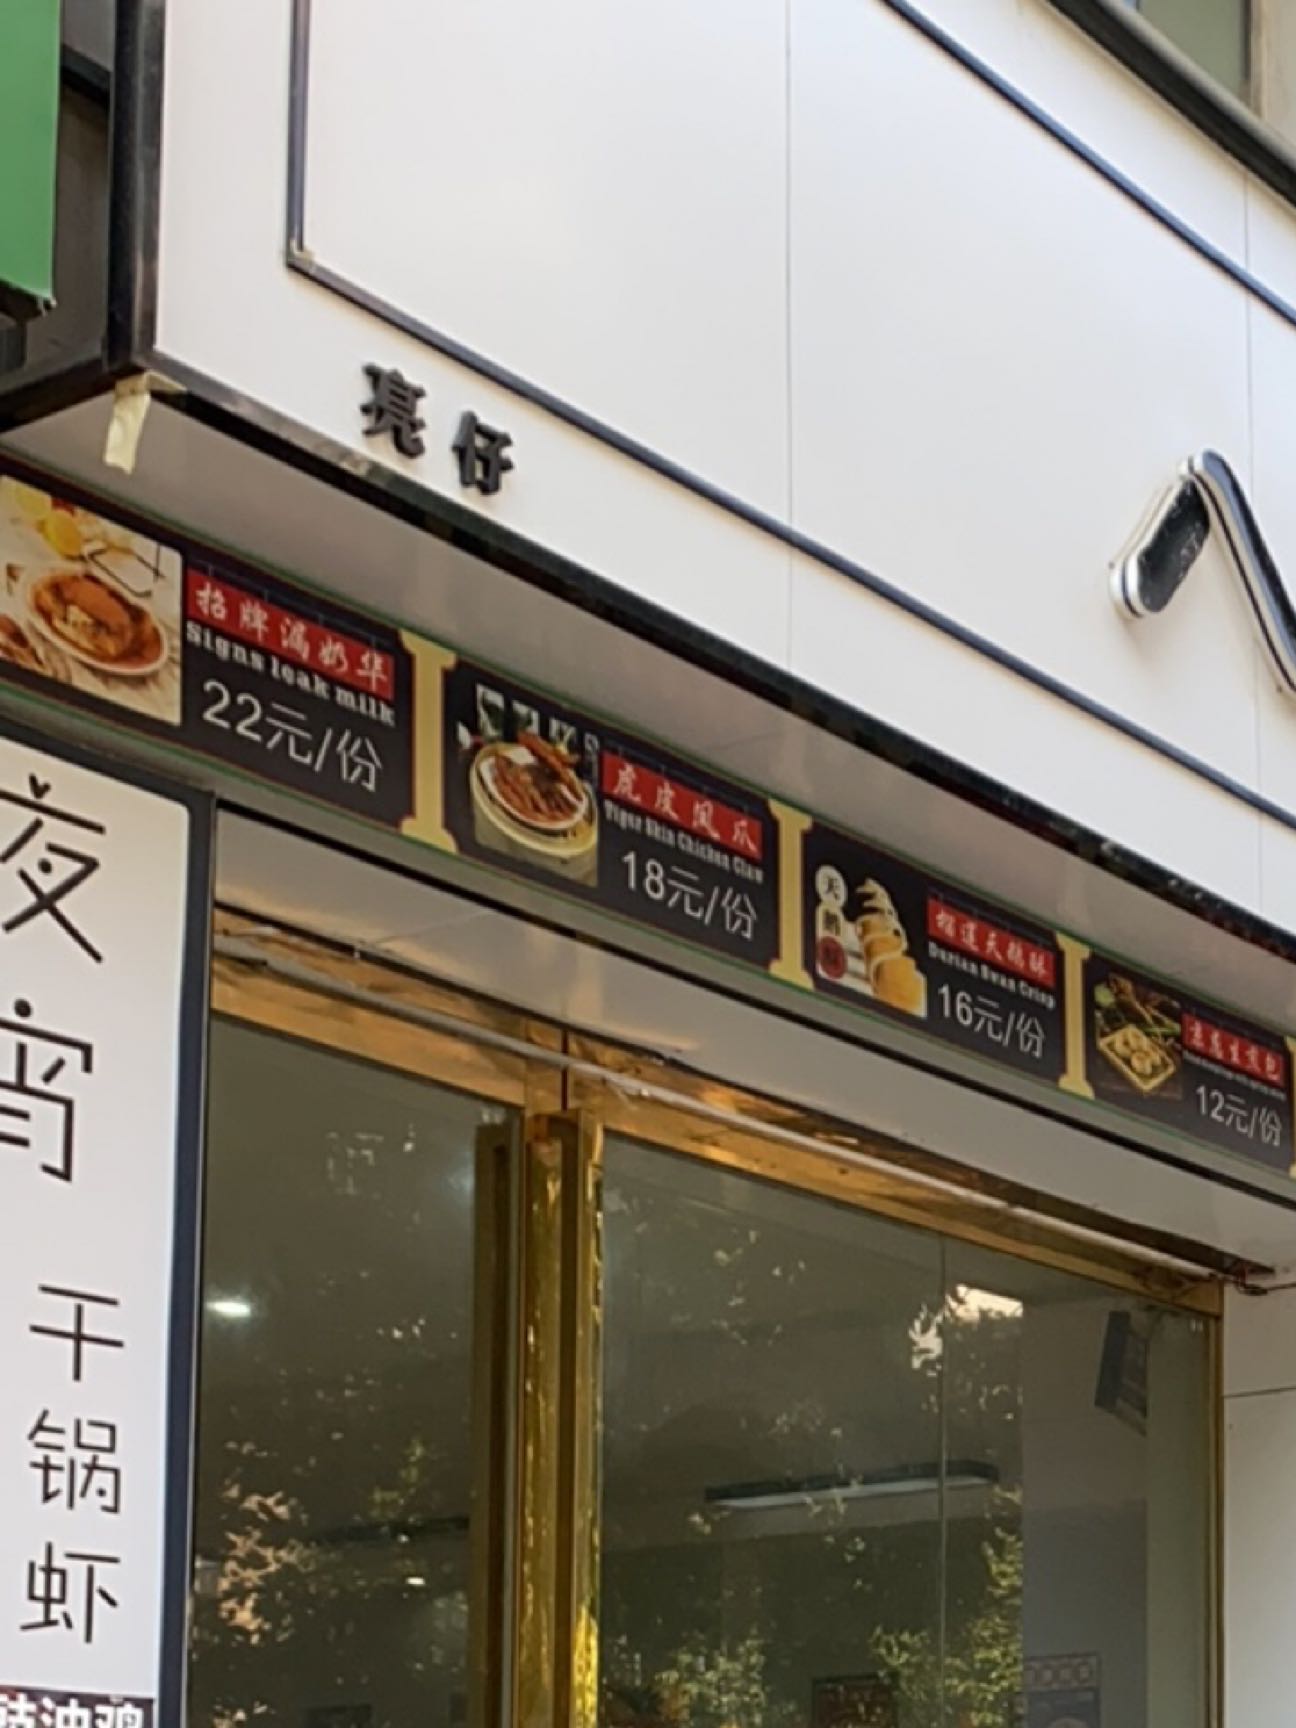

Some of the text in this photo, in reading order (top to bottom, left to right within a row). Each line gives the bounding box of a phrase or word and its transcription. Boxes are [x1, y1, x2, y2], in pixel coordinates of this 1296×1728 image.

[202, 678, 383, 790] 22元/份
[621, 850, 758, 941] 18元/份
[937, 983, 1045, 1059] 16元/份
[1195, 1085, 1283, 1147] 12元/份
[20, 1285, 125, 1643] 干锅虾
